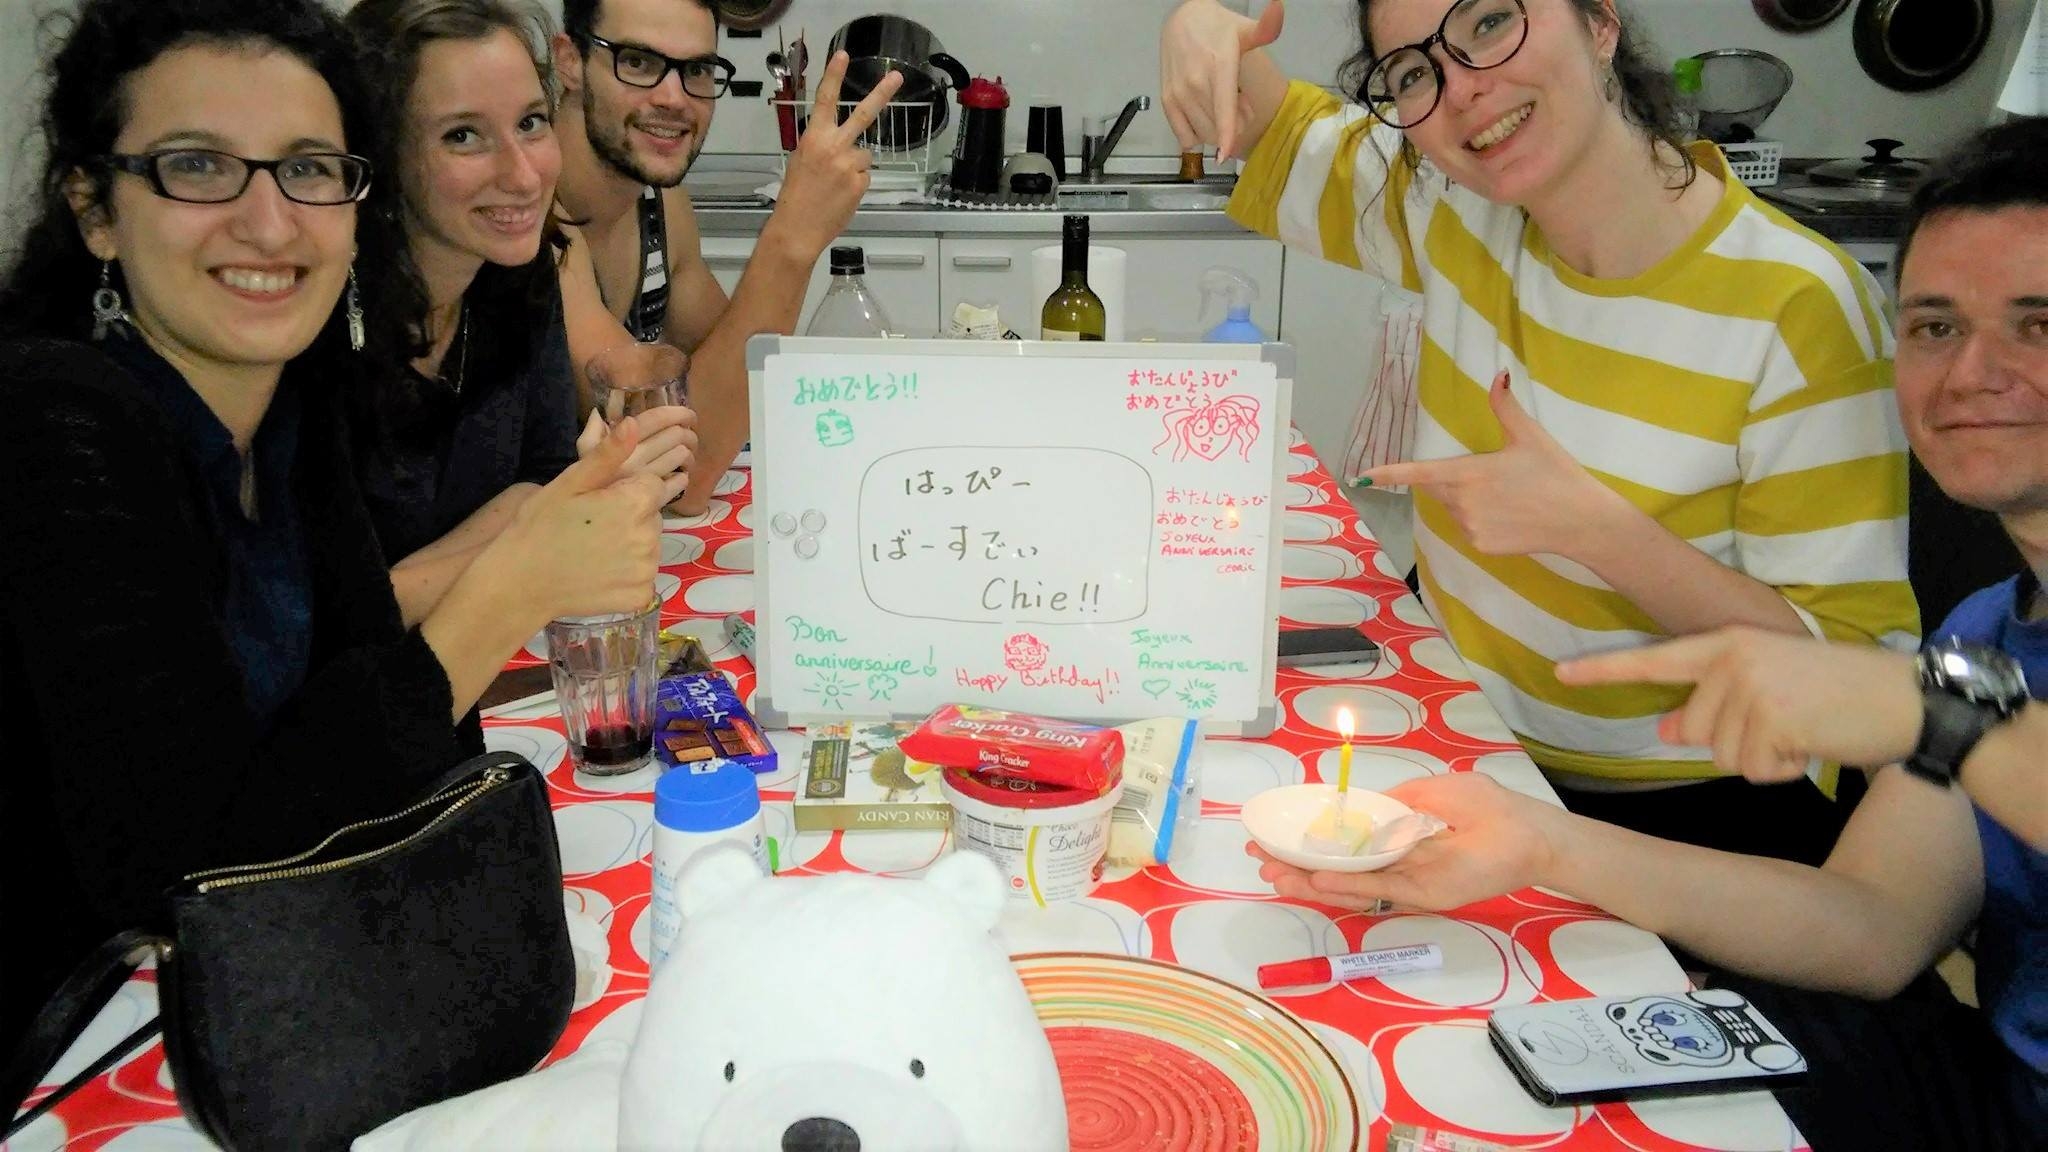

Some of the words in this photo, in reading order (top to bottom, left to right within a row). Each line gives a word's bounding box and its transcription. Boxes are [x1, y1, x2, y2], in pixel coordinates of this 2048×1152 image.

[905, 466, 1031, 495] はっぴー
[785, 615, 848, 642] Bon
[956, 667, 1008, 693] Happy
[950, 718, 1030, 740] Cracker
[1035, 728, 1087, 749] King
[978, 749, 999, 763] King
[1000, 751, 1031, 768] Cracker
[857, 810, 911, 823] CANDY
[915, 810, 950, 822] RIAN
[1340, 956, 1366, 966] WHITE
[1367, 952, 1396, 962] BOARD
[1397, 947, 1432, 959] MARKER
